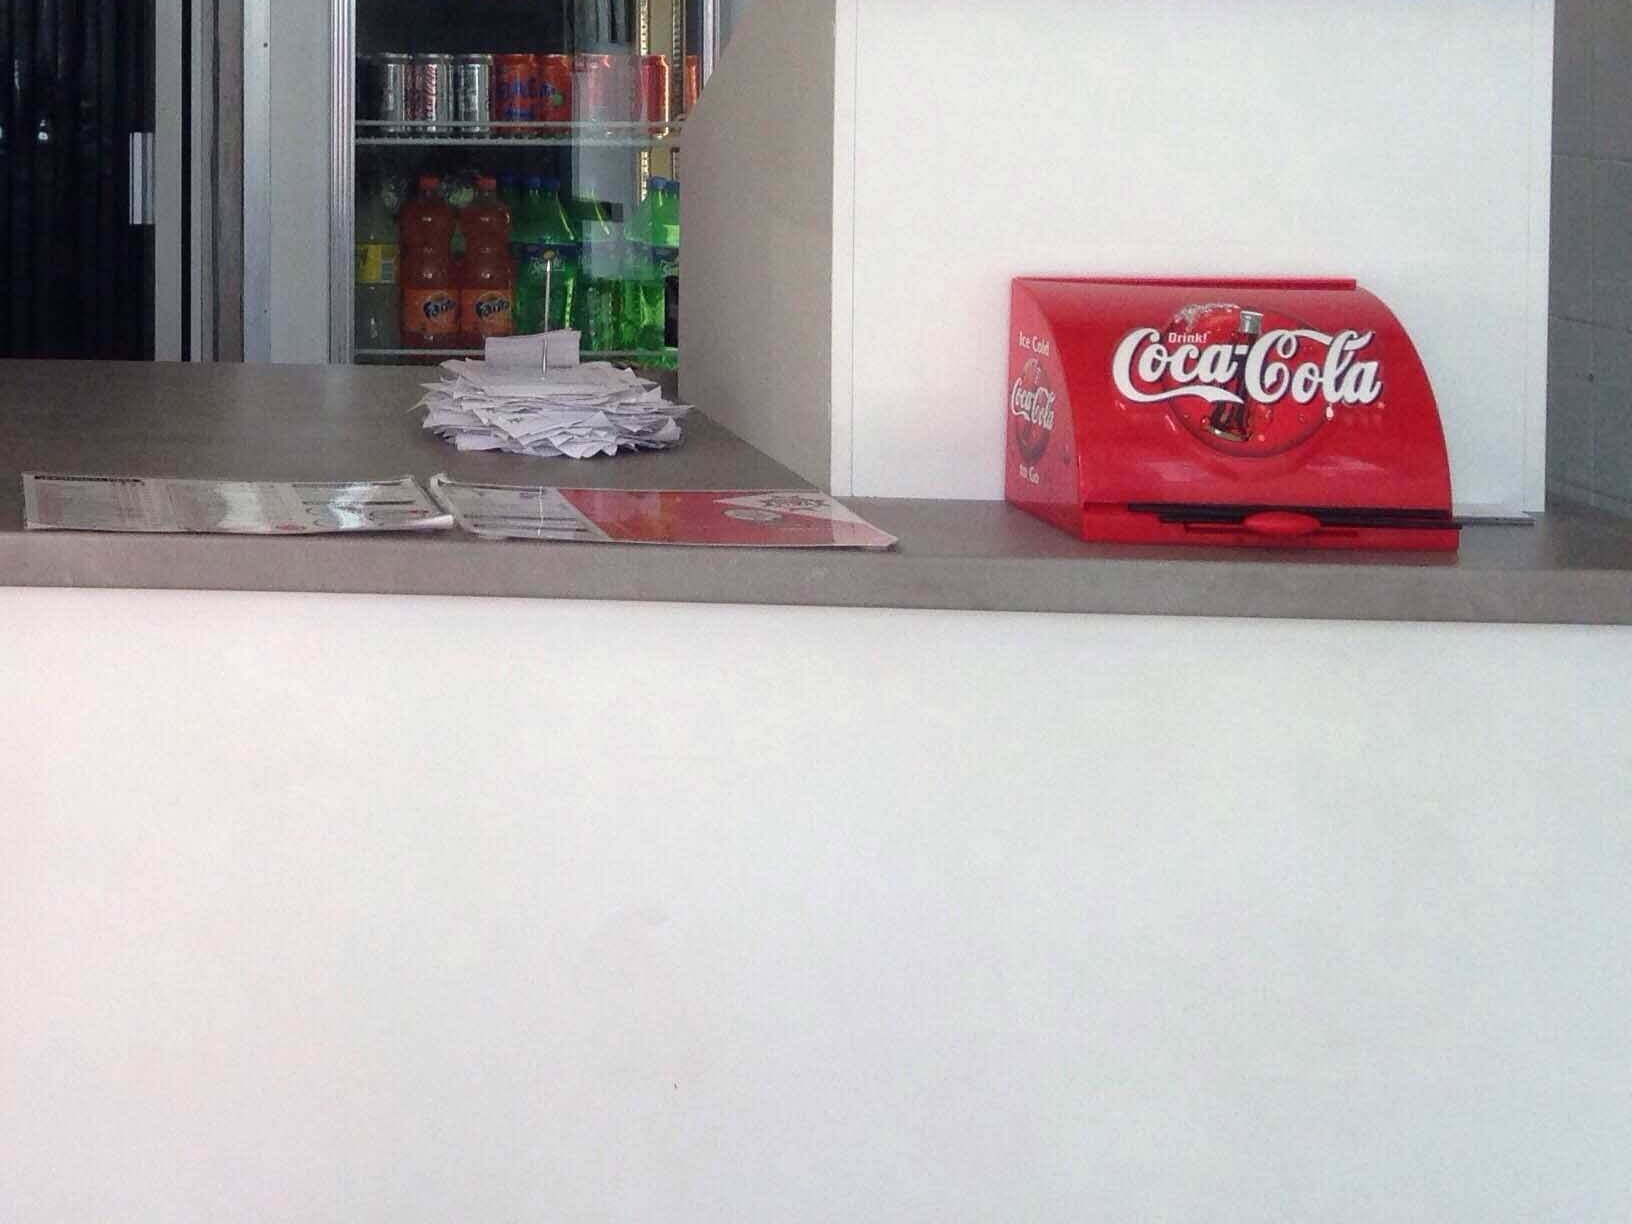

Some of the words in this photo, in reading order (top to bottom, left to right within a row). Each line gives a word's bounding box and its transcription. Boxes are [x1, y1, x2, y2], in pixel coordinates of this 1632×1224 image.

[1018, 331, 1030, 349] Ice
[1032, 335, 1050, 356] Cold
[1168, 332, 1207, 343] Drink!
[1112, 327, 1381, 404] Coca-Cola
